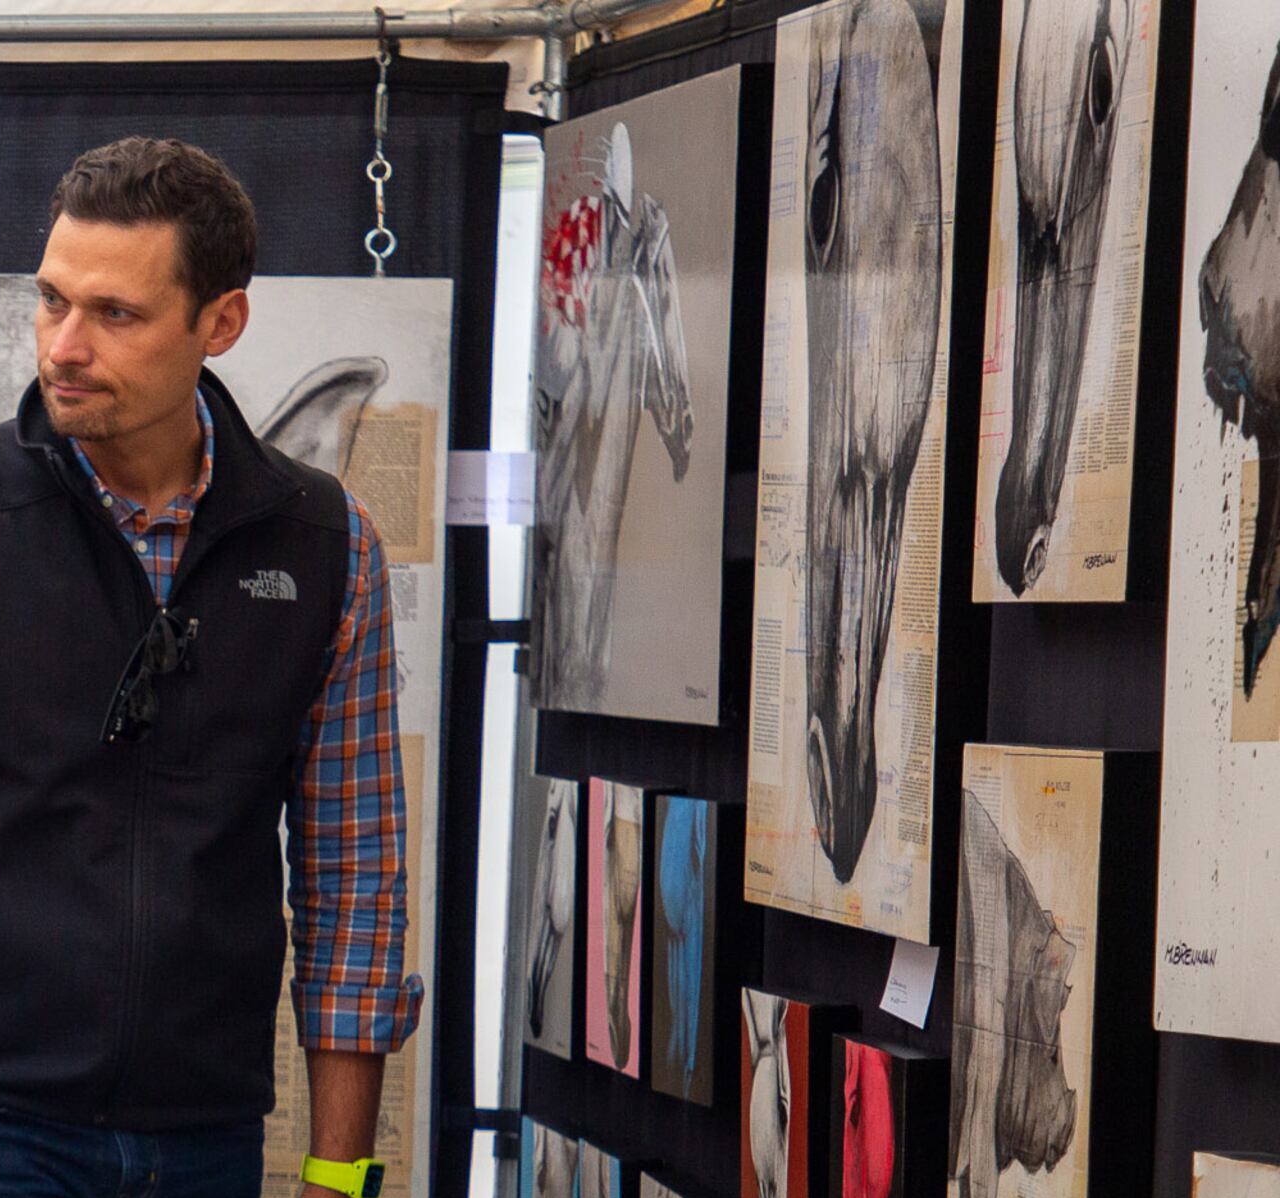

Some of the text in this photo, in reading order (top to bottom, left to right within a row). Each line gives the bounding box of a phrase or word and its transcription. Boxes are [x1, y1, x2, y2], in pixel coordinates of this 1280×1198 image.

[256, 570, 278, 580] THE
[239, 580, 279, 590] NORTH
[251, 589, 279, 600] FACE
